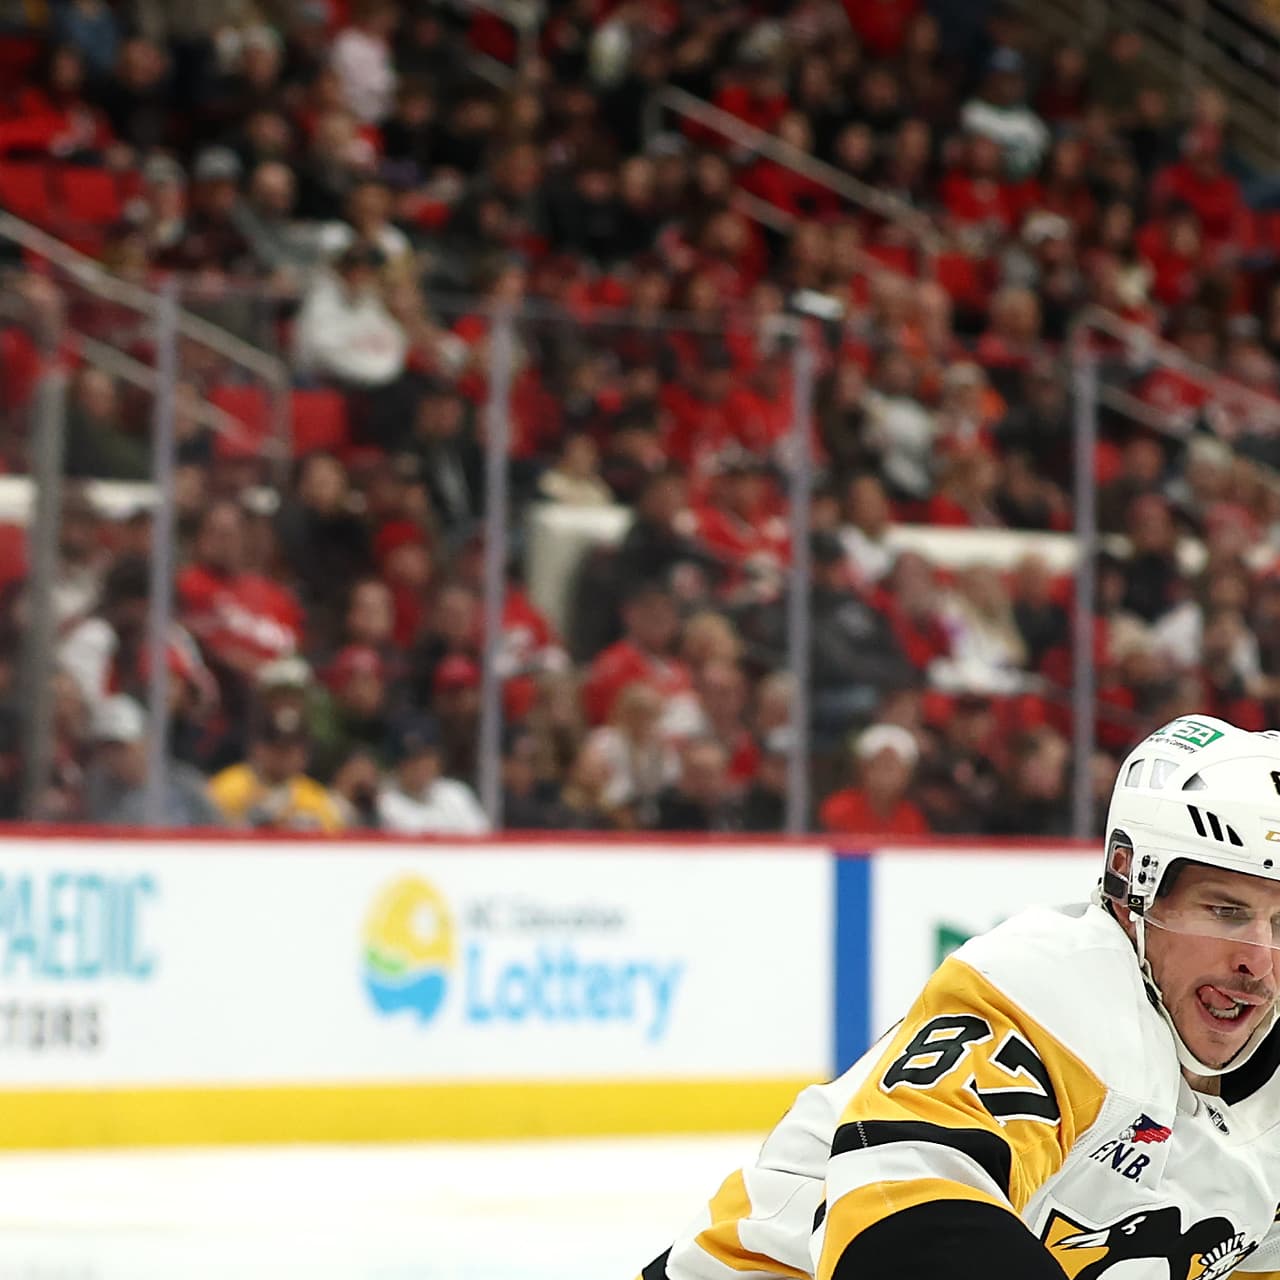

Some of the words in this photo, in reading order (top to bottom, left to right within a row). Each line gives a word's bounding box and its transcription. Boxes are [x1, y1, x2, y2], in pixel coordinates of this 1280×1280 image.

[0, 872, 158, 981] AEDIC
[466, 941, 688, 1044] Lottery
[879, 1013, 1062, 1128] 87
